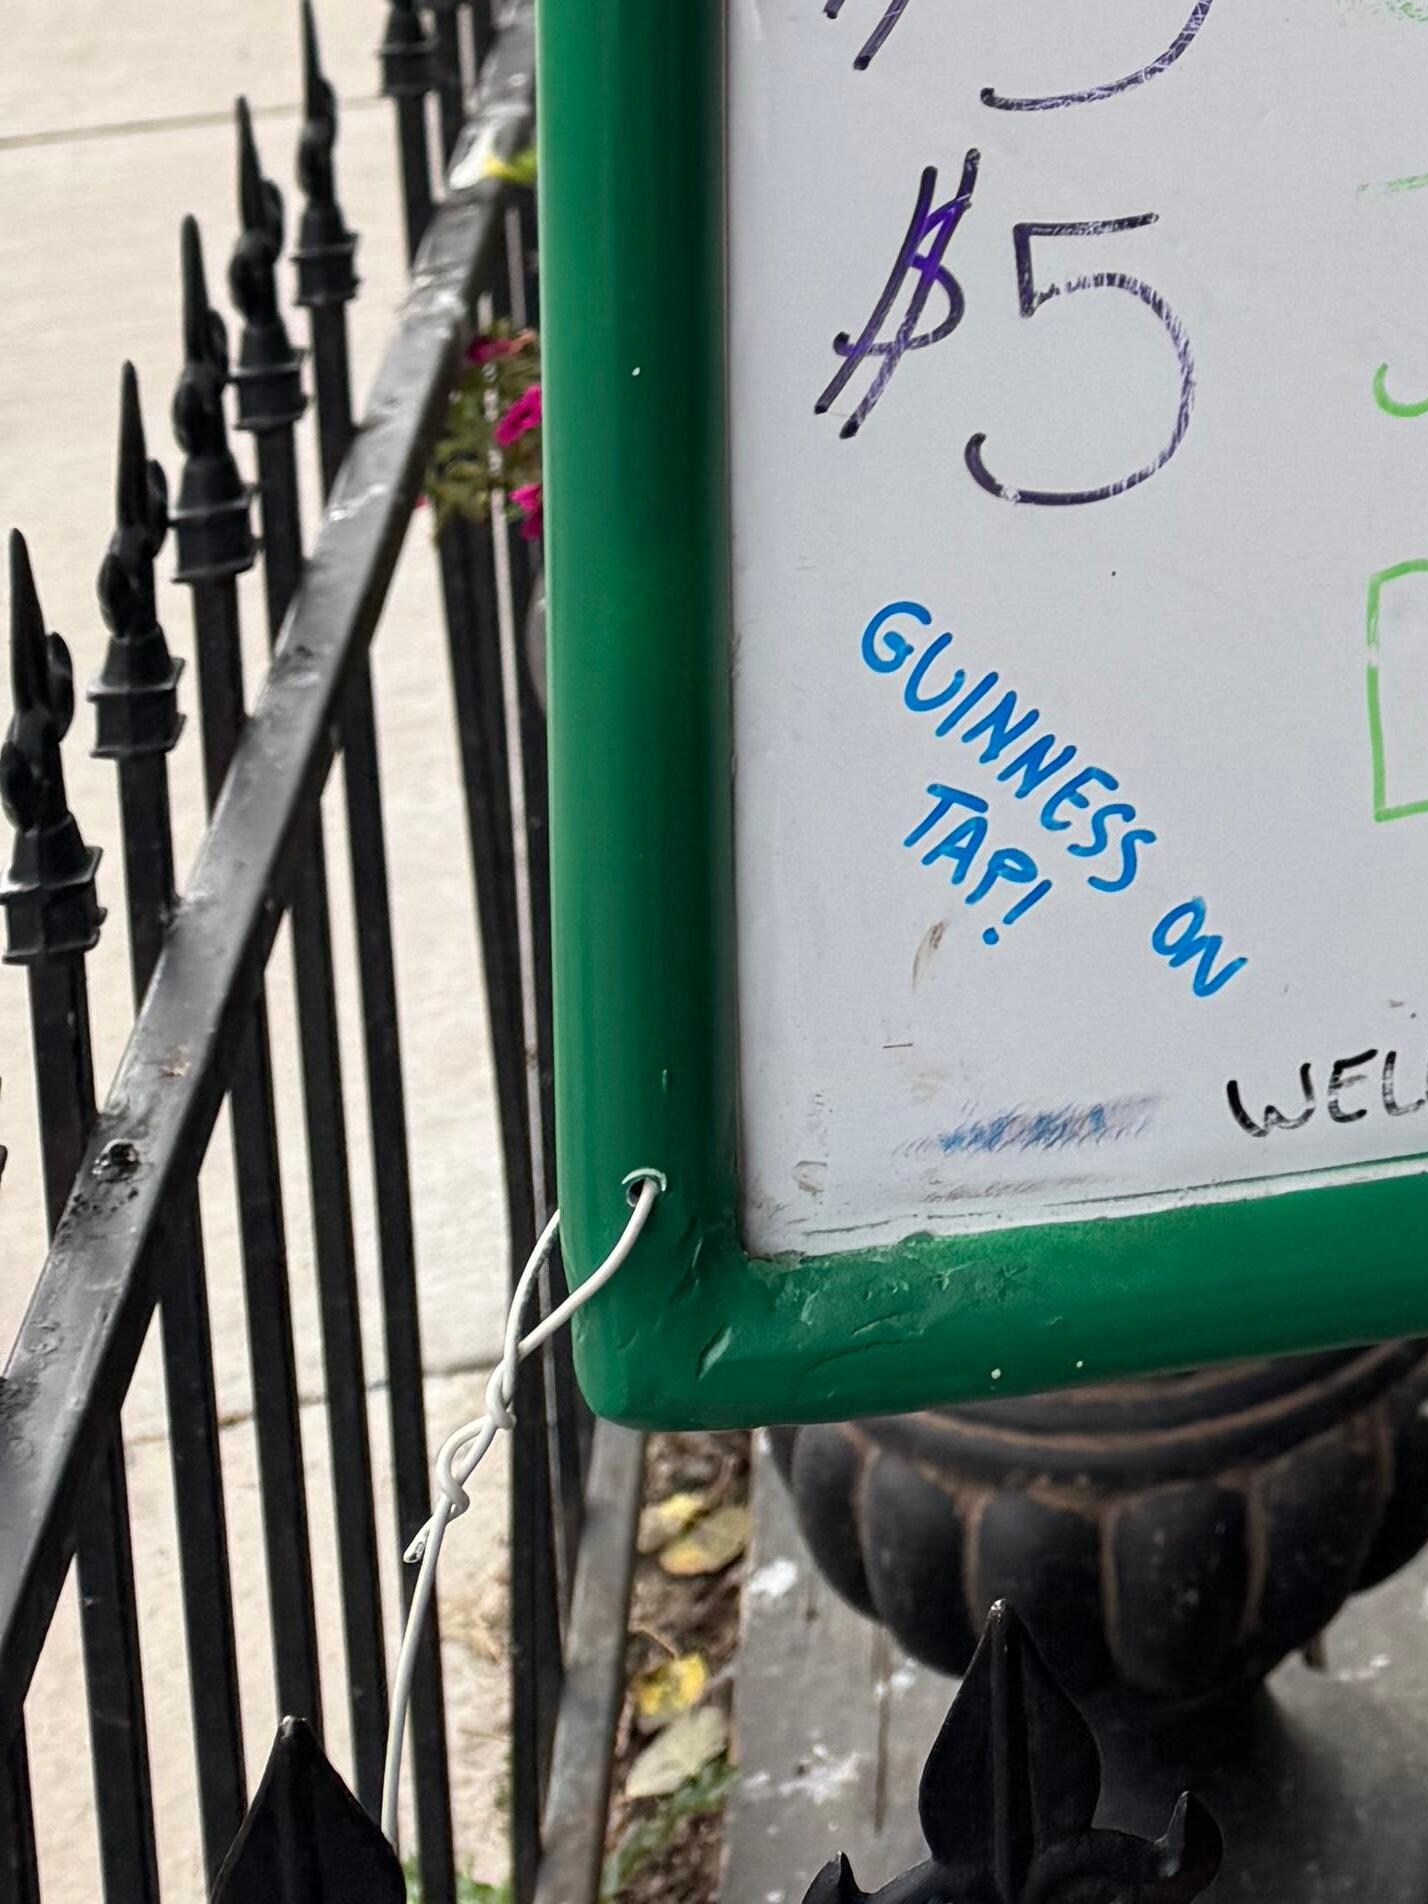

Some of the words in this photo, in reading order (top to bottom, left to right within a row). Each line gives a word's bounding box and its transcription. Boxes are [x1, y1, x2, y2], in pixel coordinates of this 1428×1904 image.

[812, 147, 1194, 508] $5
[859, 599, 1158, 895] GUINNESS
[1150, 896, 1249, 999] ON
[902, 782, 1054, 947] TAP!
